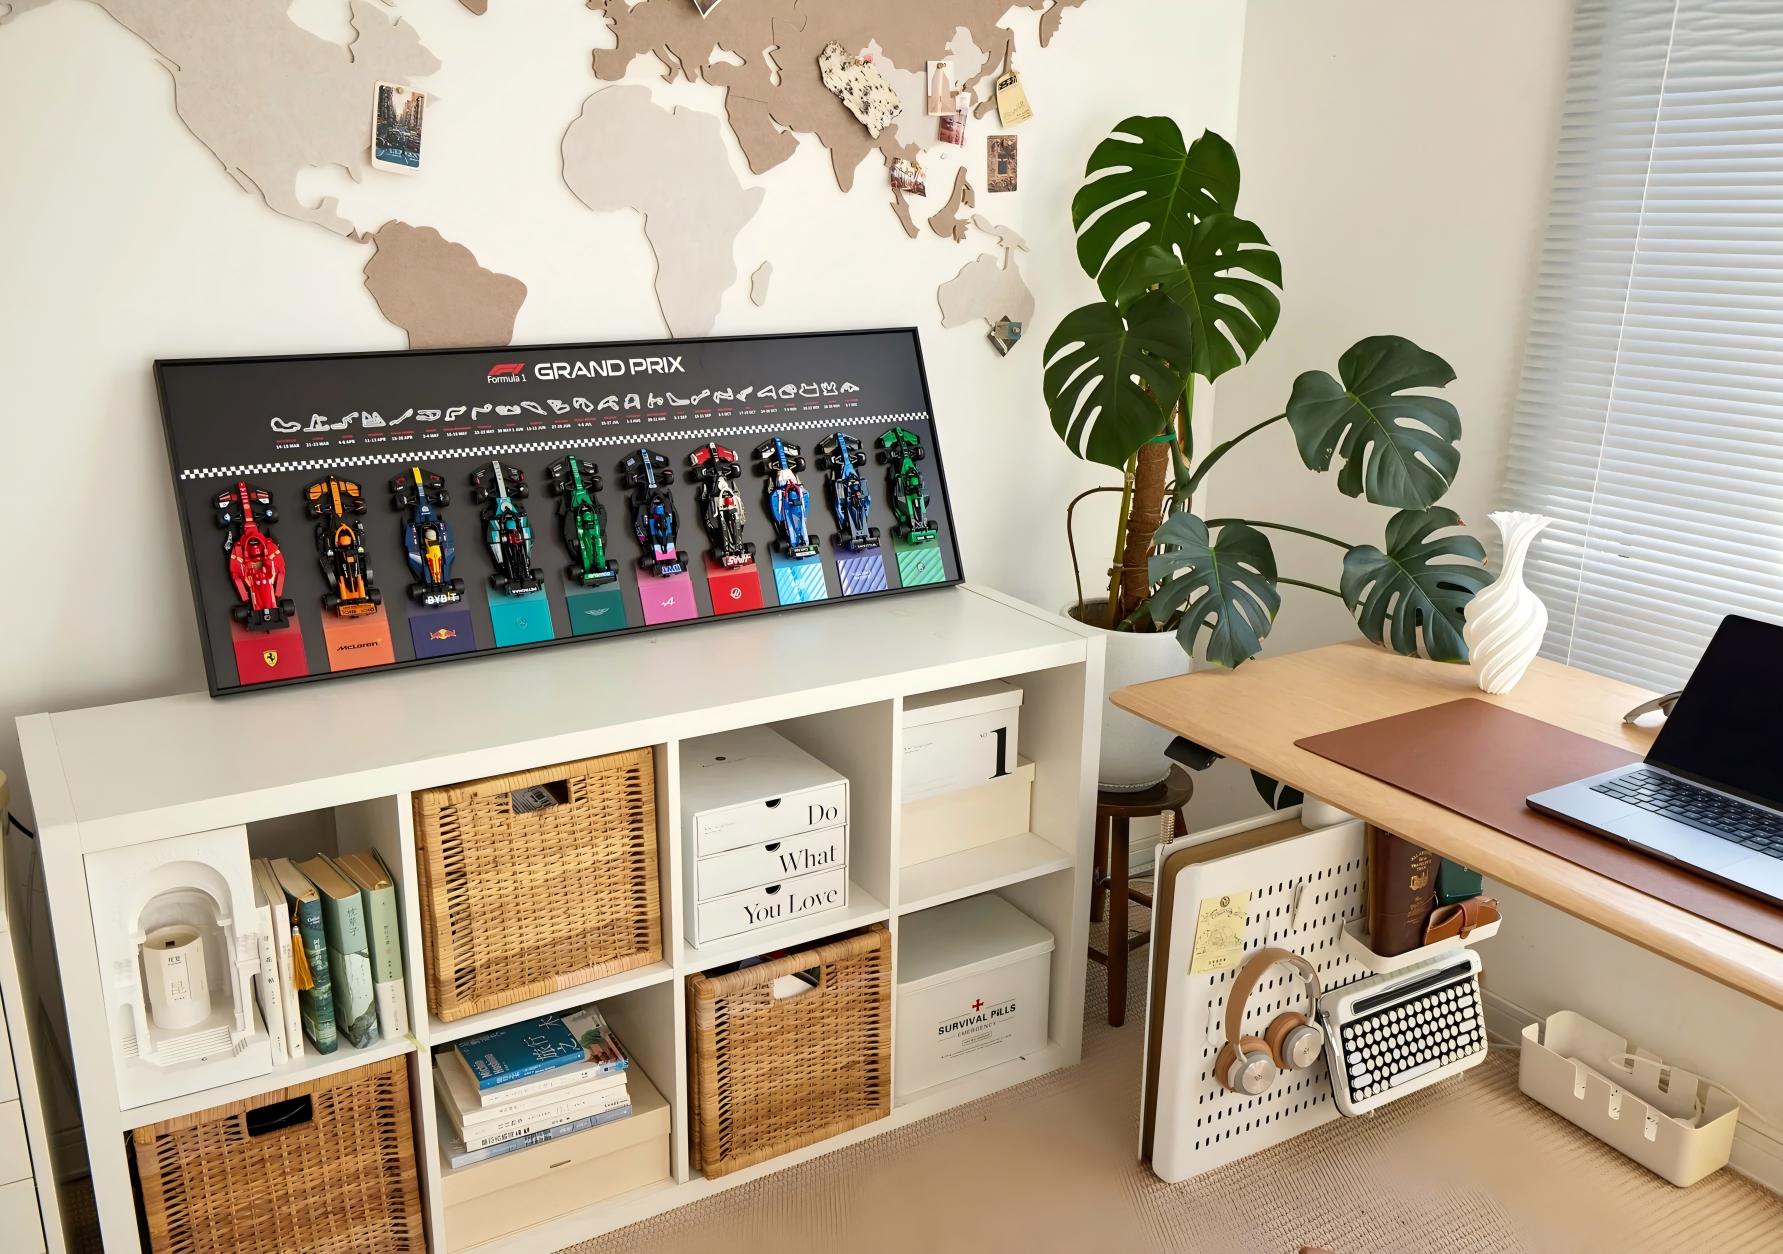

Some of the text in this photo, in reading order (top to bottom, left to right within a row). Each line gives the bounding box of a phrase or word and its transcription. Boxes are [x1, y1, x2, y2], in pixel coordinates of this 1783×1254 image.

[534, 356, 685, 380] GRAND PRIX
[487, 374, 526, 384] Formula 1
[427, 592, 457, 604] BYBIT
[337, 641, 378, 651] McLaren
[989, 726, 1012, 779] 1
[808, 804, 838, 825] Do
[780, 845, 836, 873] What
[744, 889, 838, 924] You Love
[938, 1014, 988, 1035] SURVIVAL
[957, 1022, 996, 1037] EMERGENCY
